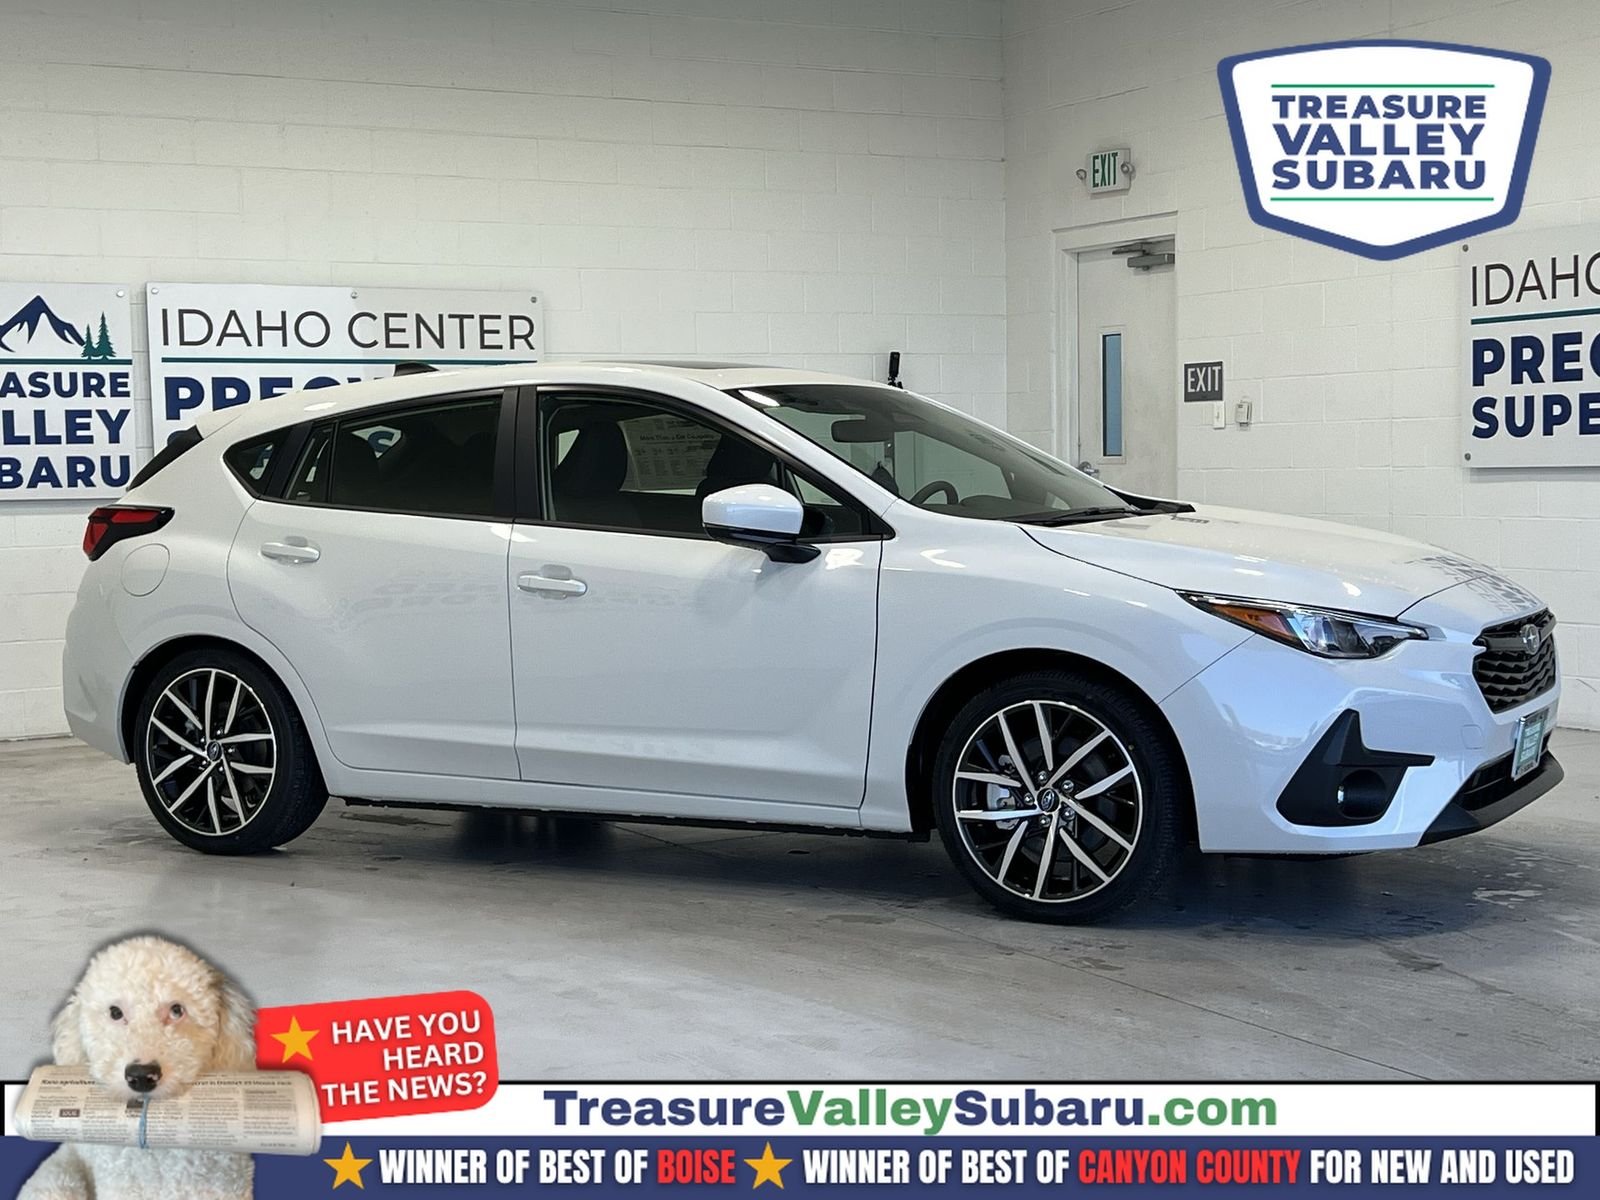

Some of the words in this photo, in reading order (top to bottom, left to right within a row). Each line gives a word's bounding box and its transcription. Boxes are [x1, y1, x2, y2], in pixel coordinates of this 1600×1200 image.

[1092, 151, 1118, 188] EXIT
[162, 308, 331, 348] IDAHO
[347, 312, 535, 350] CENTER
[1472, 331, 1600, 387] PRE
[1187, 366, 1221, 393] EXIT
